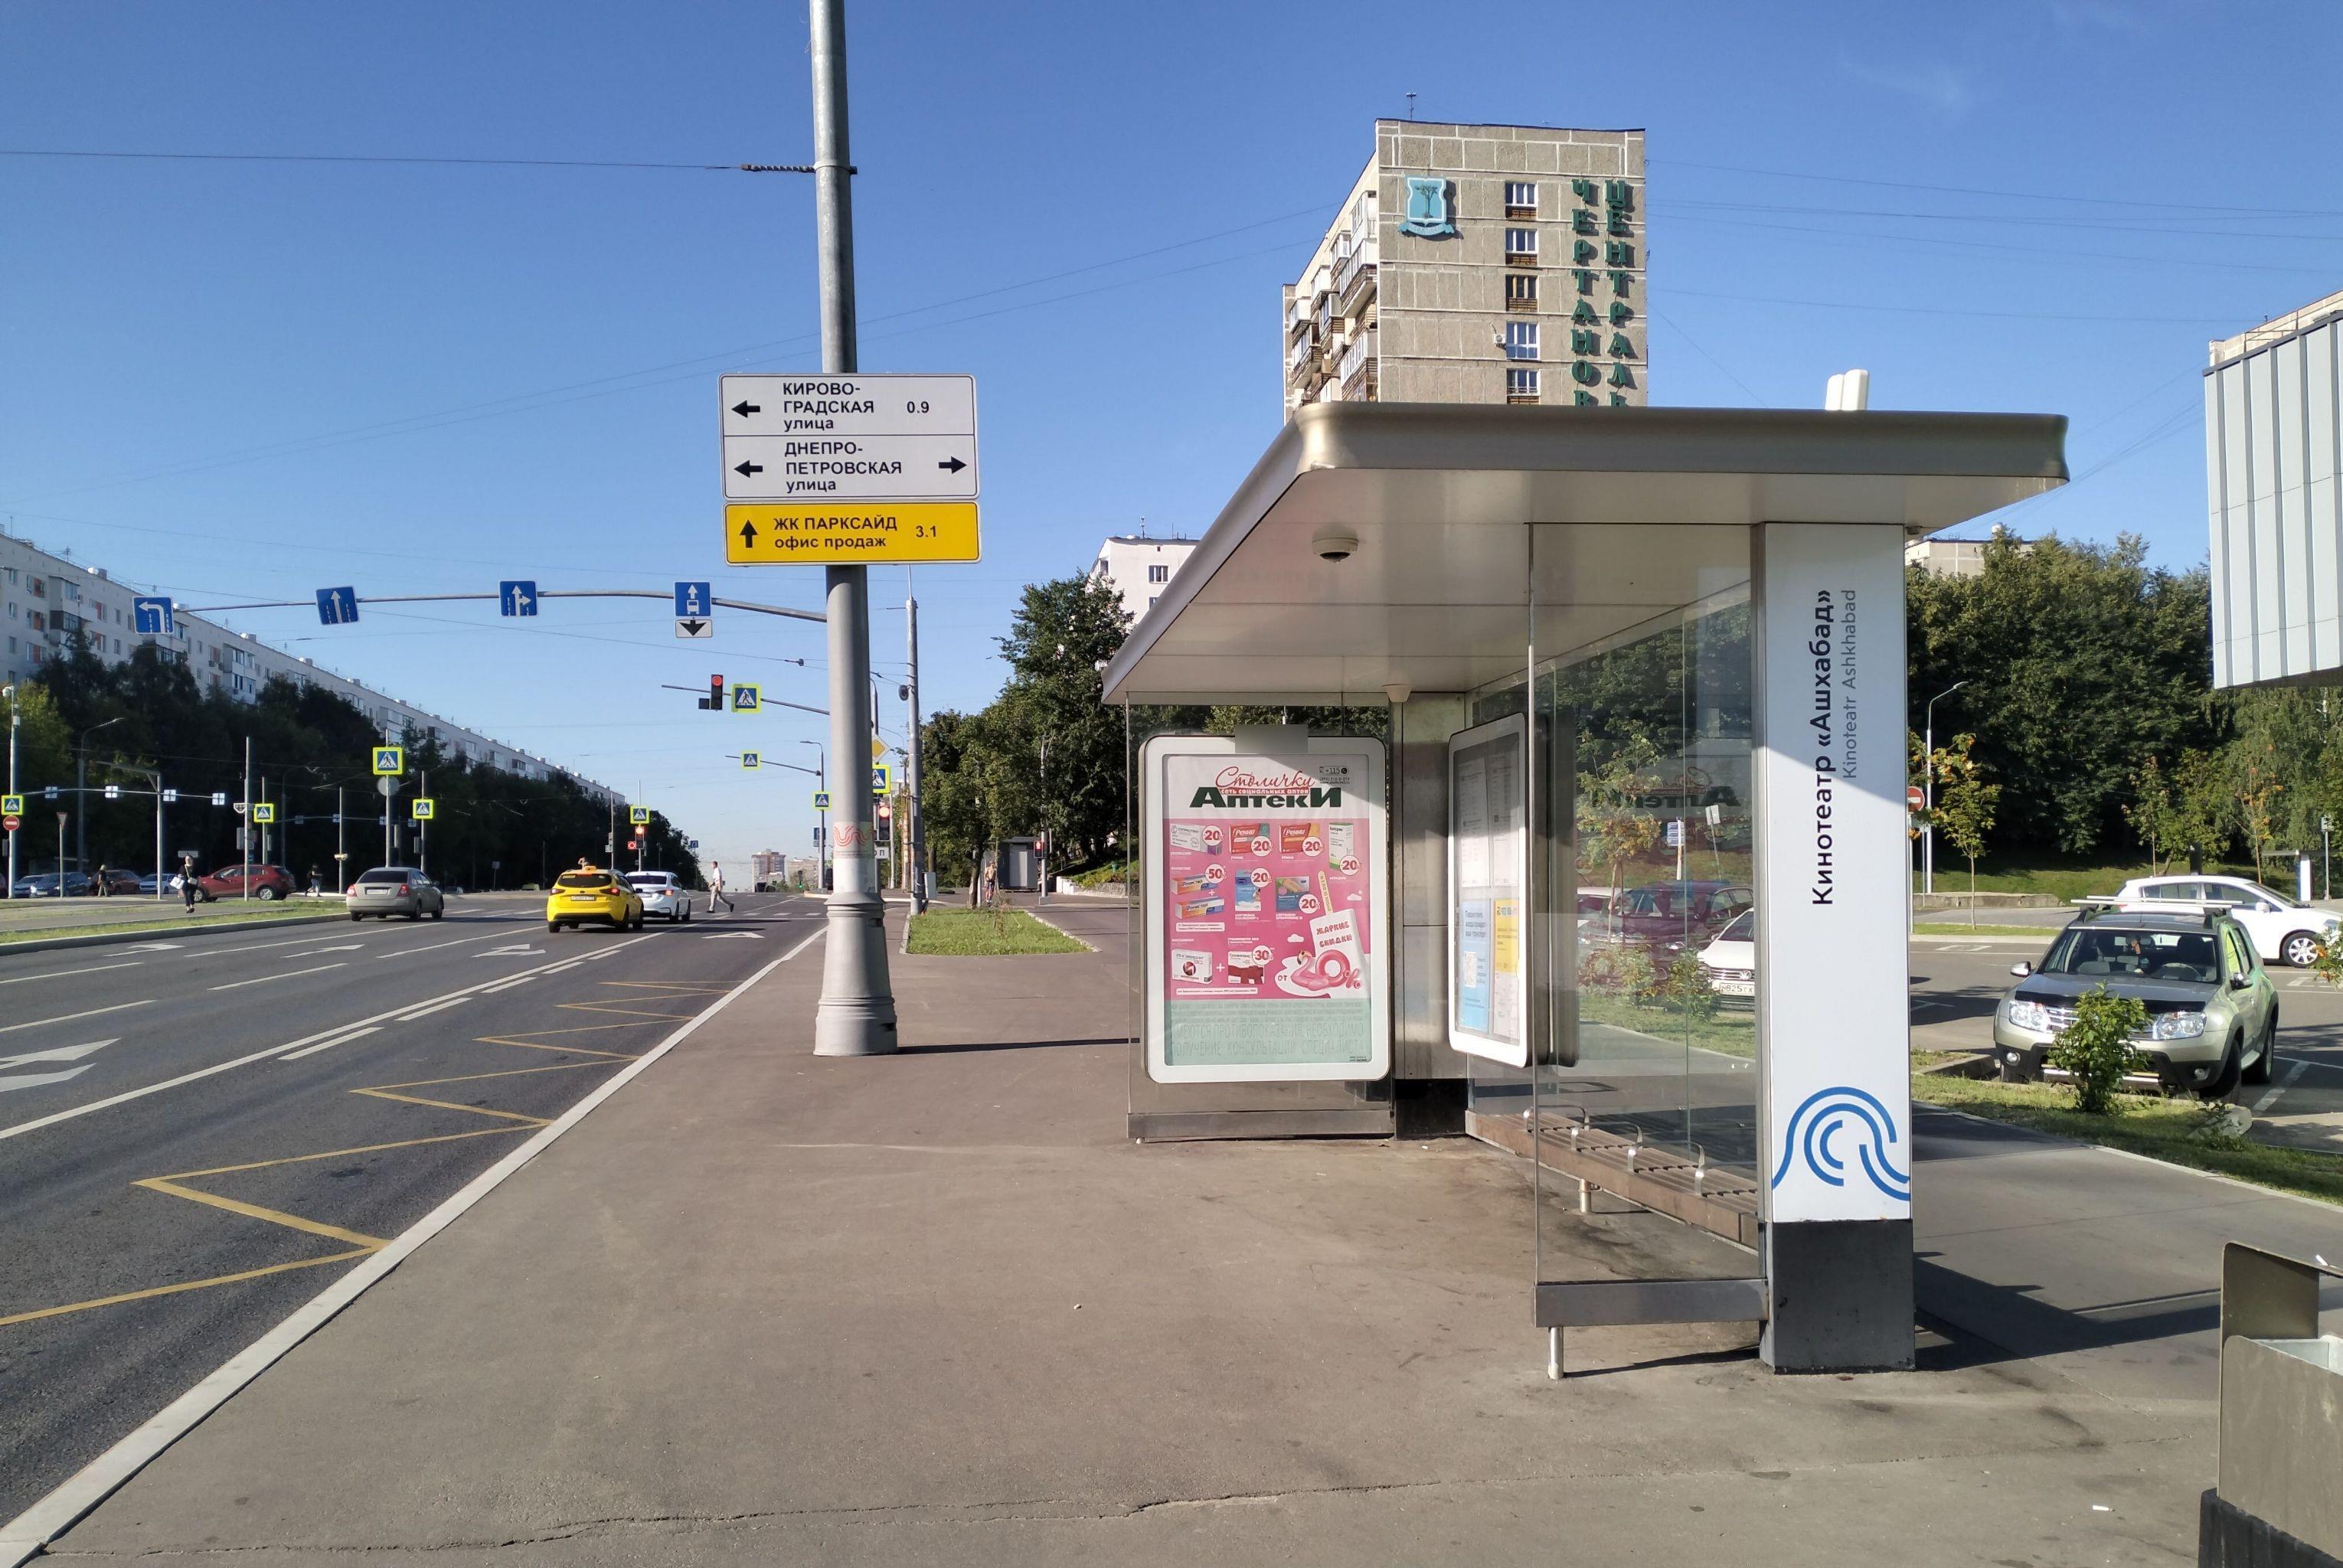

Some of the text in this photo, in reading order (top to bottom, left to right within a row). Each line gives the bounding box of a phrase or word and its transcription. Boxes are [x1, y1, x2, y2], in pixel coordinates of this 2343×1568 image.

[783, 382, 861, 396] КИРОВО-
[783, 400, 930, 415] ГРАДСКАЯ 0.9
[784, 418, 835, 433] улица
[785, 442, 863, 457] ДНЕПРО-
[786, 462, 902, 475] ПЕТРОВСКАЯ
[786, 479, 836, 494] улица
[773, 514, 937, 538] ЖК ПАРКСАЙД 3.1
[774, 537, 887, 550] офис продаж
[1841, 589, 1857, 779] Kinoteatr Ashkhabad
[1809, 589, 1836, 905] Кинотеатр «Ашхабад»
[1215, 766, 1315, 788] Столички
[1319, 934, 1352, 948] СКИДКИ
